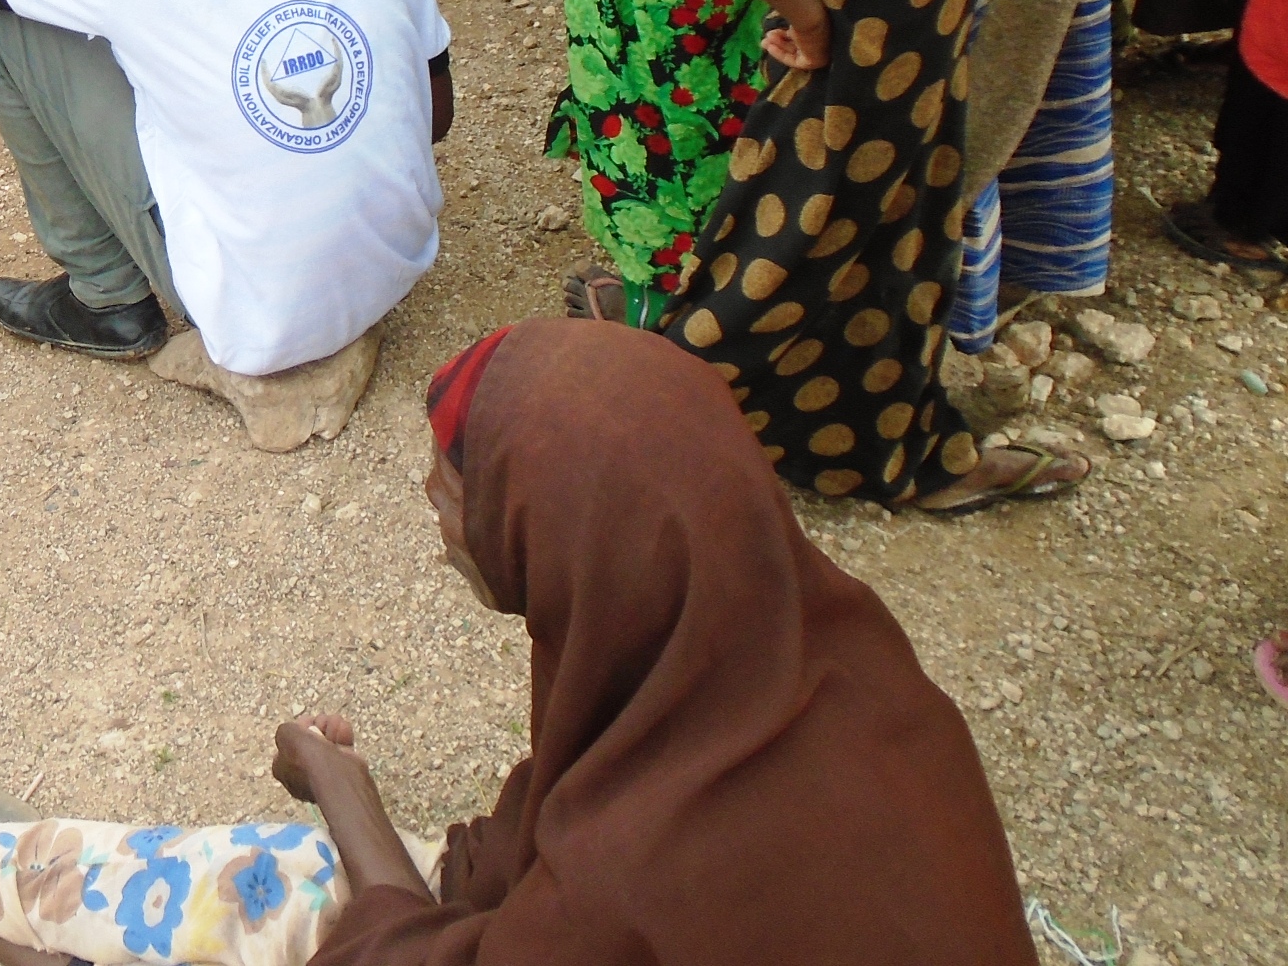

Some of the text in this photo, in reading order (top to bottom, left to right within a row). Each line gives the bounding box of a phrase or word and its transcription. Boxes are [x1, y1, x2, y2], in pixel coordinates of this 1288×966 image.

[239, 7, 365, 146] IDIL RELIEF, REHABILITATION & DEVELOPMENT ORGANIZATION
[282, 50, 325, 76] IRRDO
